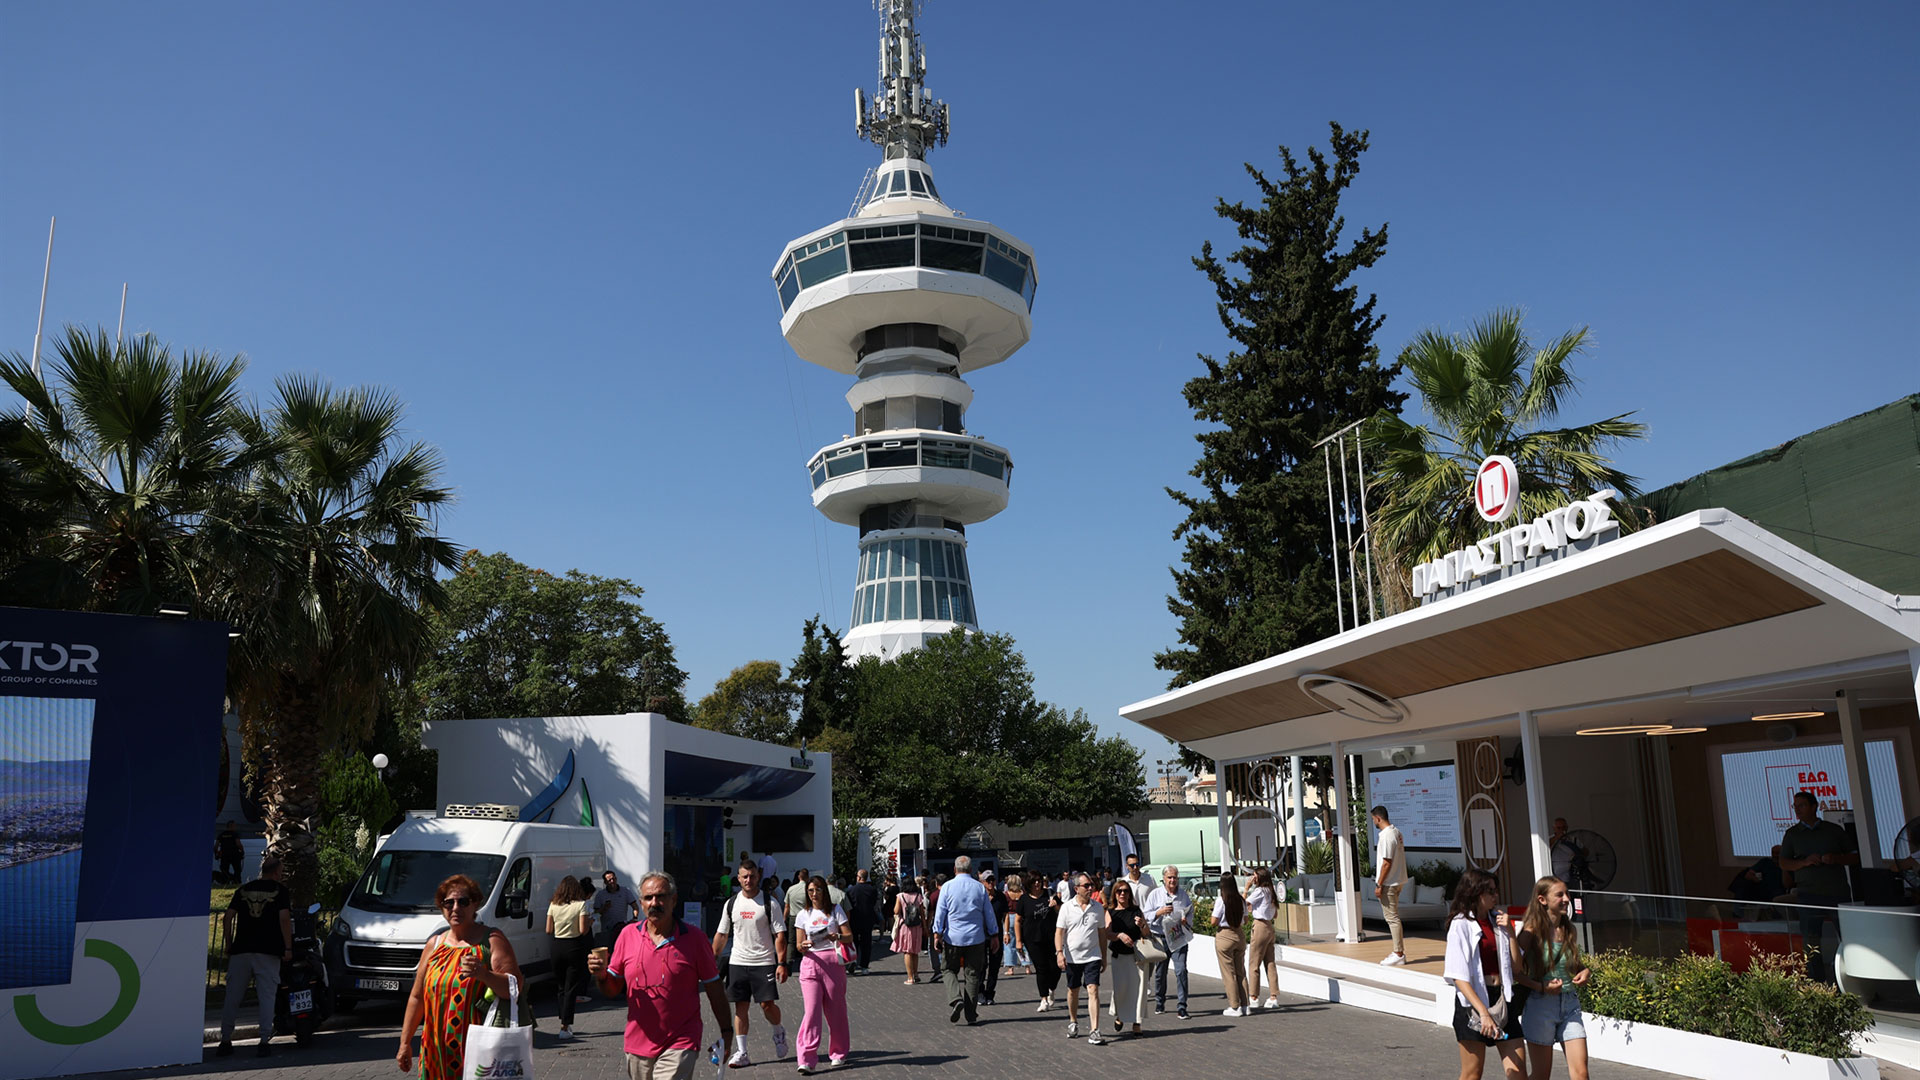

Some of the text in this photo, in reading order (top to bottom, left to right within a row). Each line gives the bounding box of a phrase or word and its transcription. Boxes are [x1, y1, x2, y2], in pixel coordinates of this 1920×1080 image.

[1412, 489, 1620, 598] ΠΑΠΑΣΤΡΑΤΟΣ
[1, 675, 98, 686] GROUP OF COMPANIES
[1798, 771, 1828, 783] ΕΔΩ
